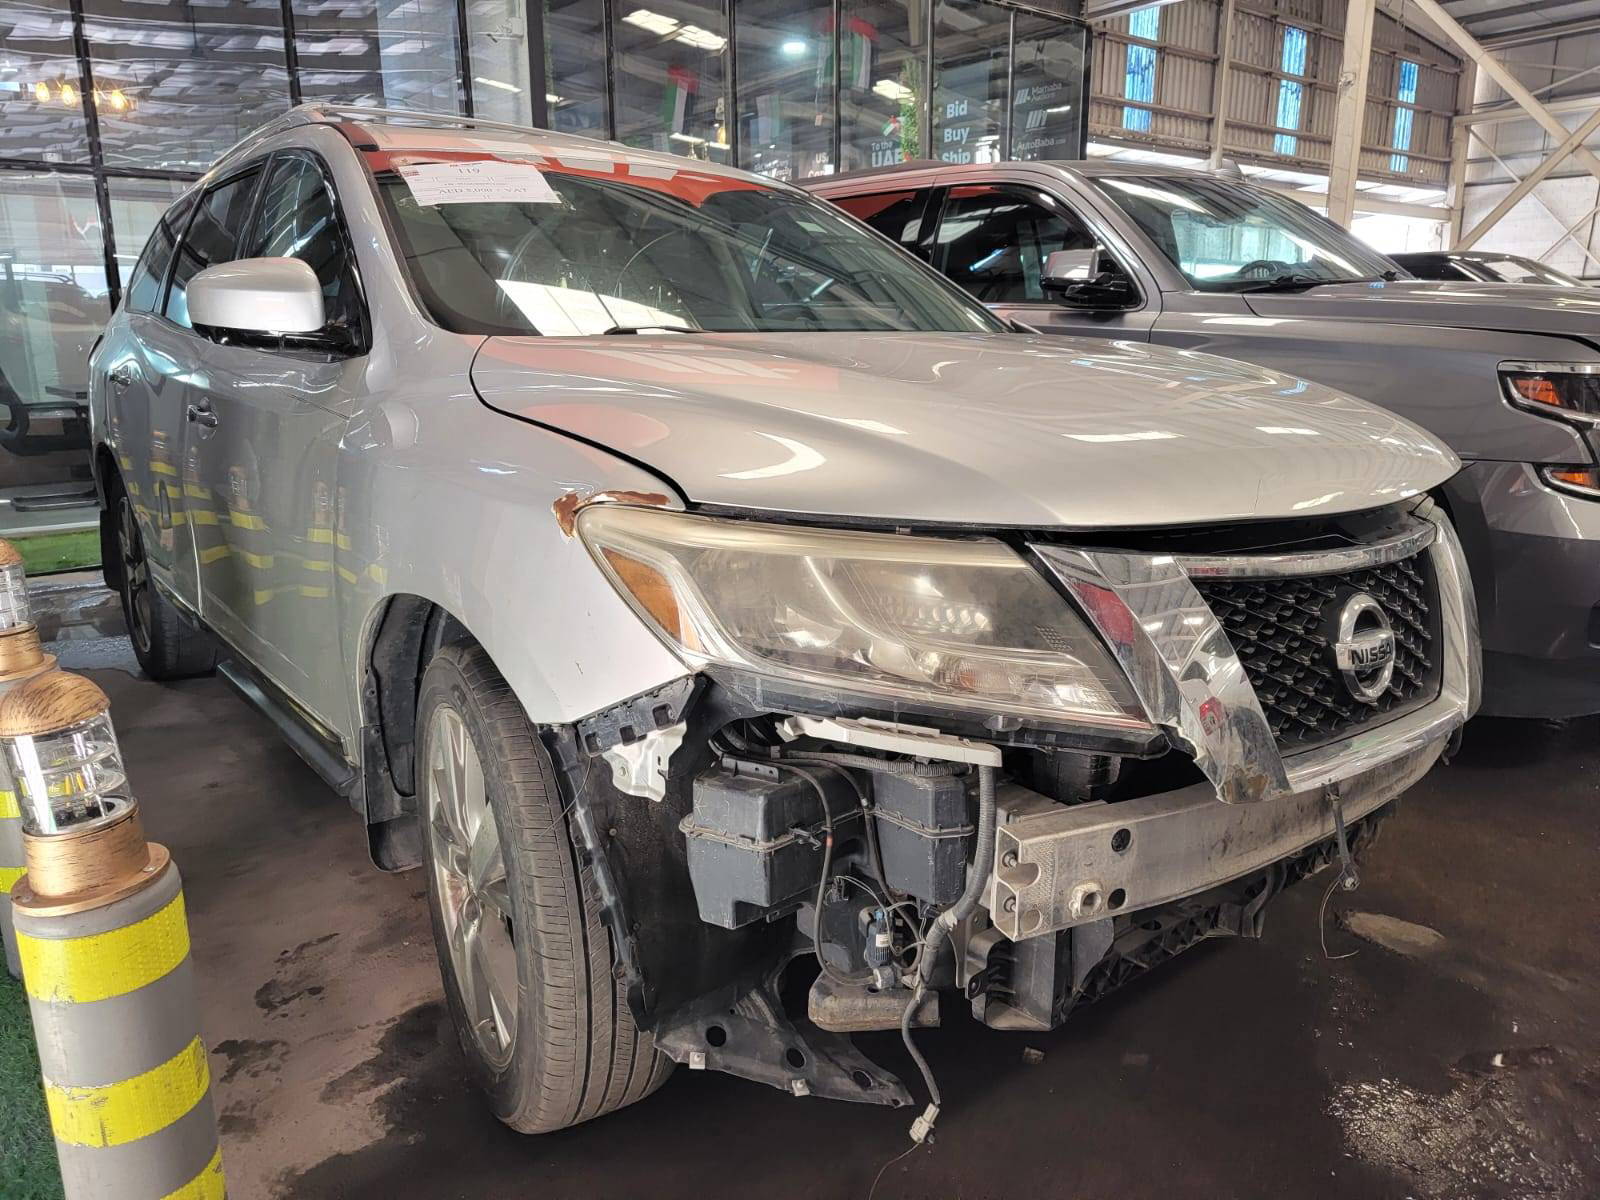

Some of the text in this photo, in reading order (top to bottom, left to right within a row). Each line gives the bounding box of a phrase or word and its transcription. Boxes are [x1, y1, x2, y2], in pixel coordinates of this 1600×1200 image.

[946, 100, 968, 119] Bid
[943, 127, 970, 145] Buy
[871, 148, 903, 168] UAE
[1350, 642, 1392, 665] NISSA
